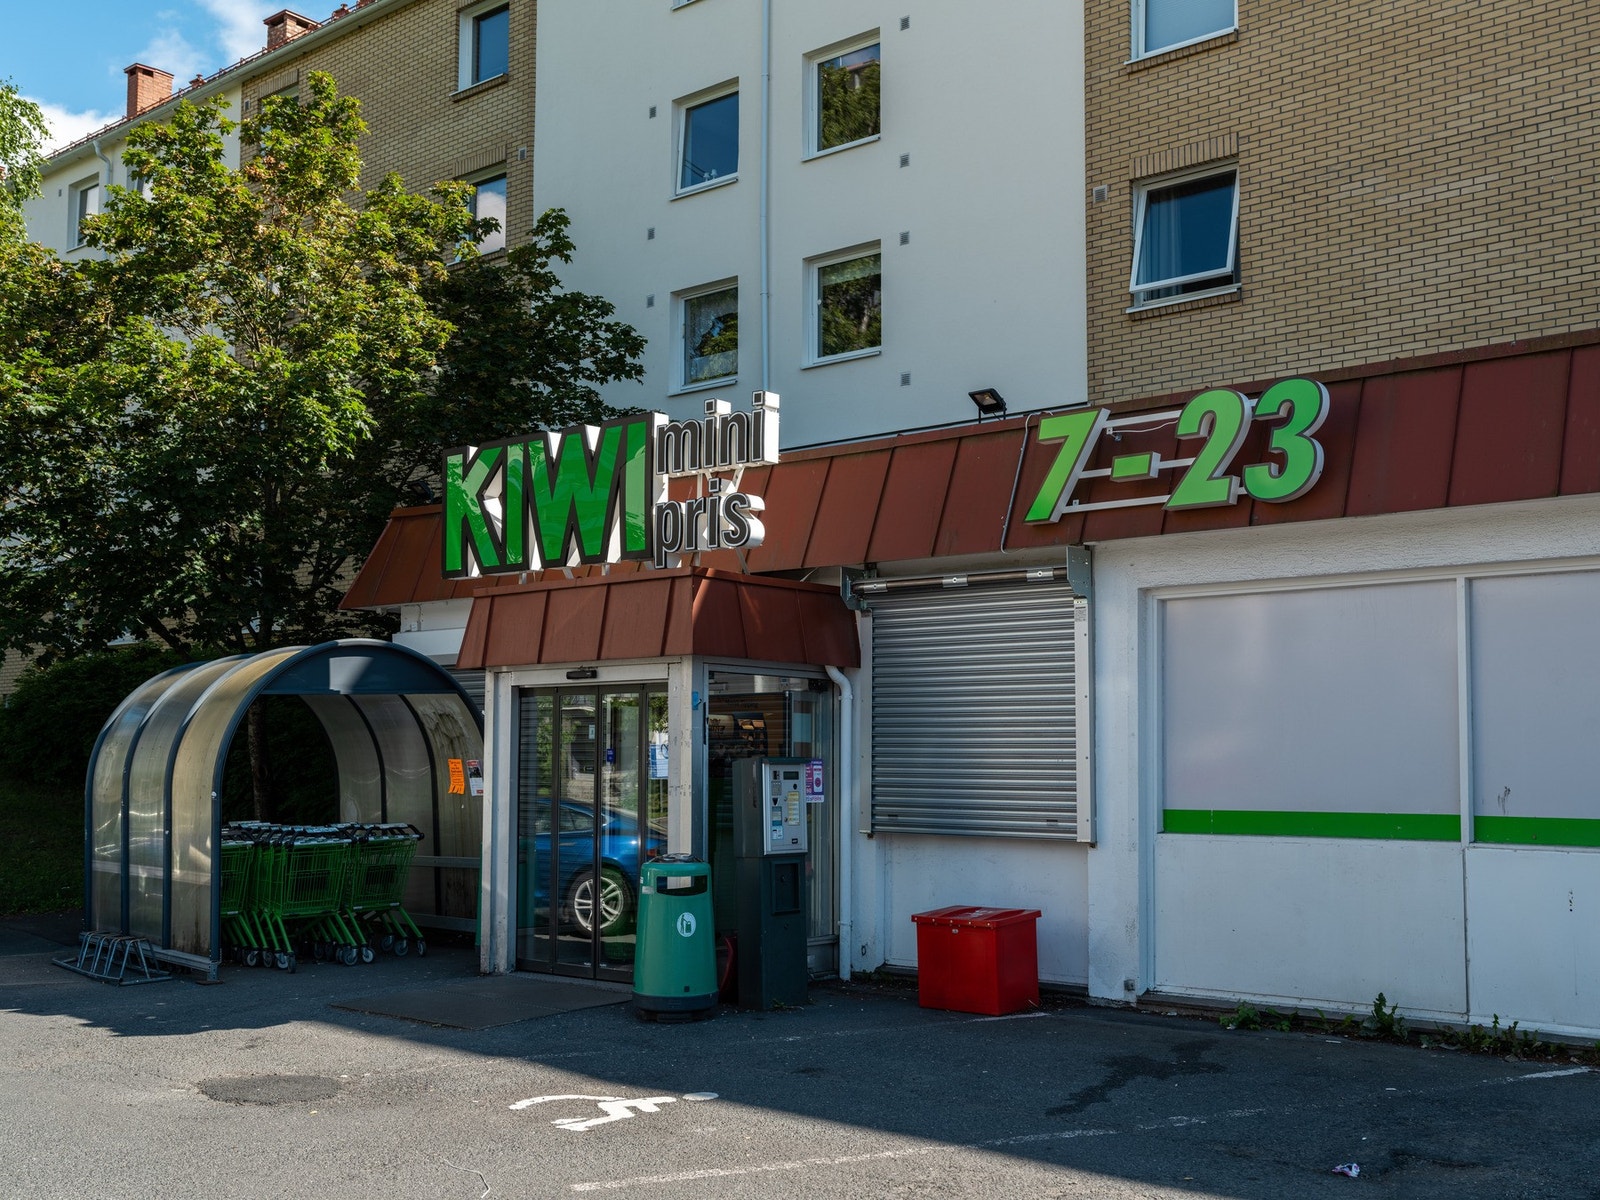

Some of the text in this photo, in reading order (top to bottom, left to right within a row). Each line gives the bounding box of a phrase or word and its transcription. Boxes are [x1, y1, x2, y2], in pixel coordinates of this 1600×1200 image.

[655, 390, 766, 475] mini
[1023, 376, 1329, 526] 7-23
[442, 411, 654, 579] KIWI
[654, 478, 752, 569] pris
